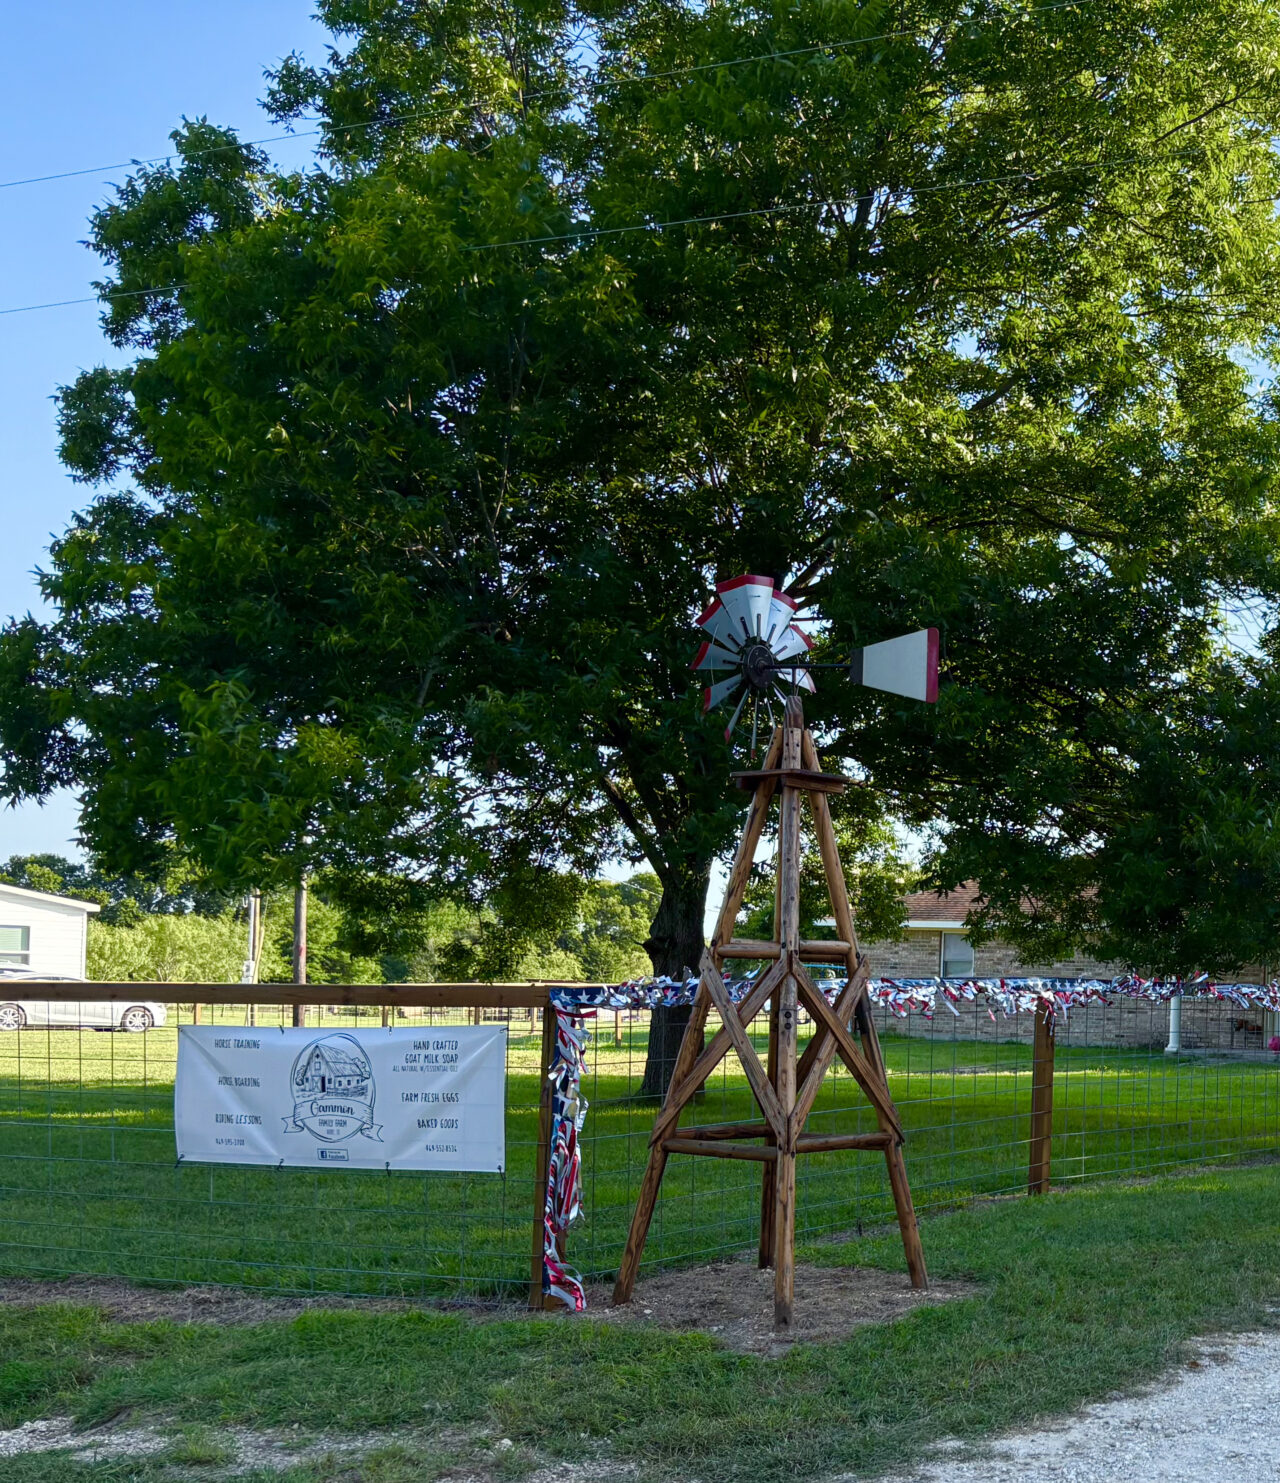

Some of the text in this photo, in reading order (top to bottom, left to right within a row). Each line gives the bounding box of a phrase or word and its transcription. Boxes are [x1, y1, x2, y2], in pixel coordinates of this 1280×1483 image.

[214, 1038, 261, 1050] HORSE TRAINING
[413, 1040, 459, 1051] HAND CRAFTED
[404, 1053, 459, 1064] GOAT MILK SOAP
[218, 1076, 261, 1088] HORSE BOARDING
[401, 1092, 460, 1103] FARM FRESH EGGS
[310, 1100, 355, 1117] Gammon
[215, 1113, 262, 1126] RIDING LESSONS
[417, 1118, 459, 1129] BAKED GOODS
